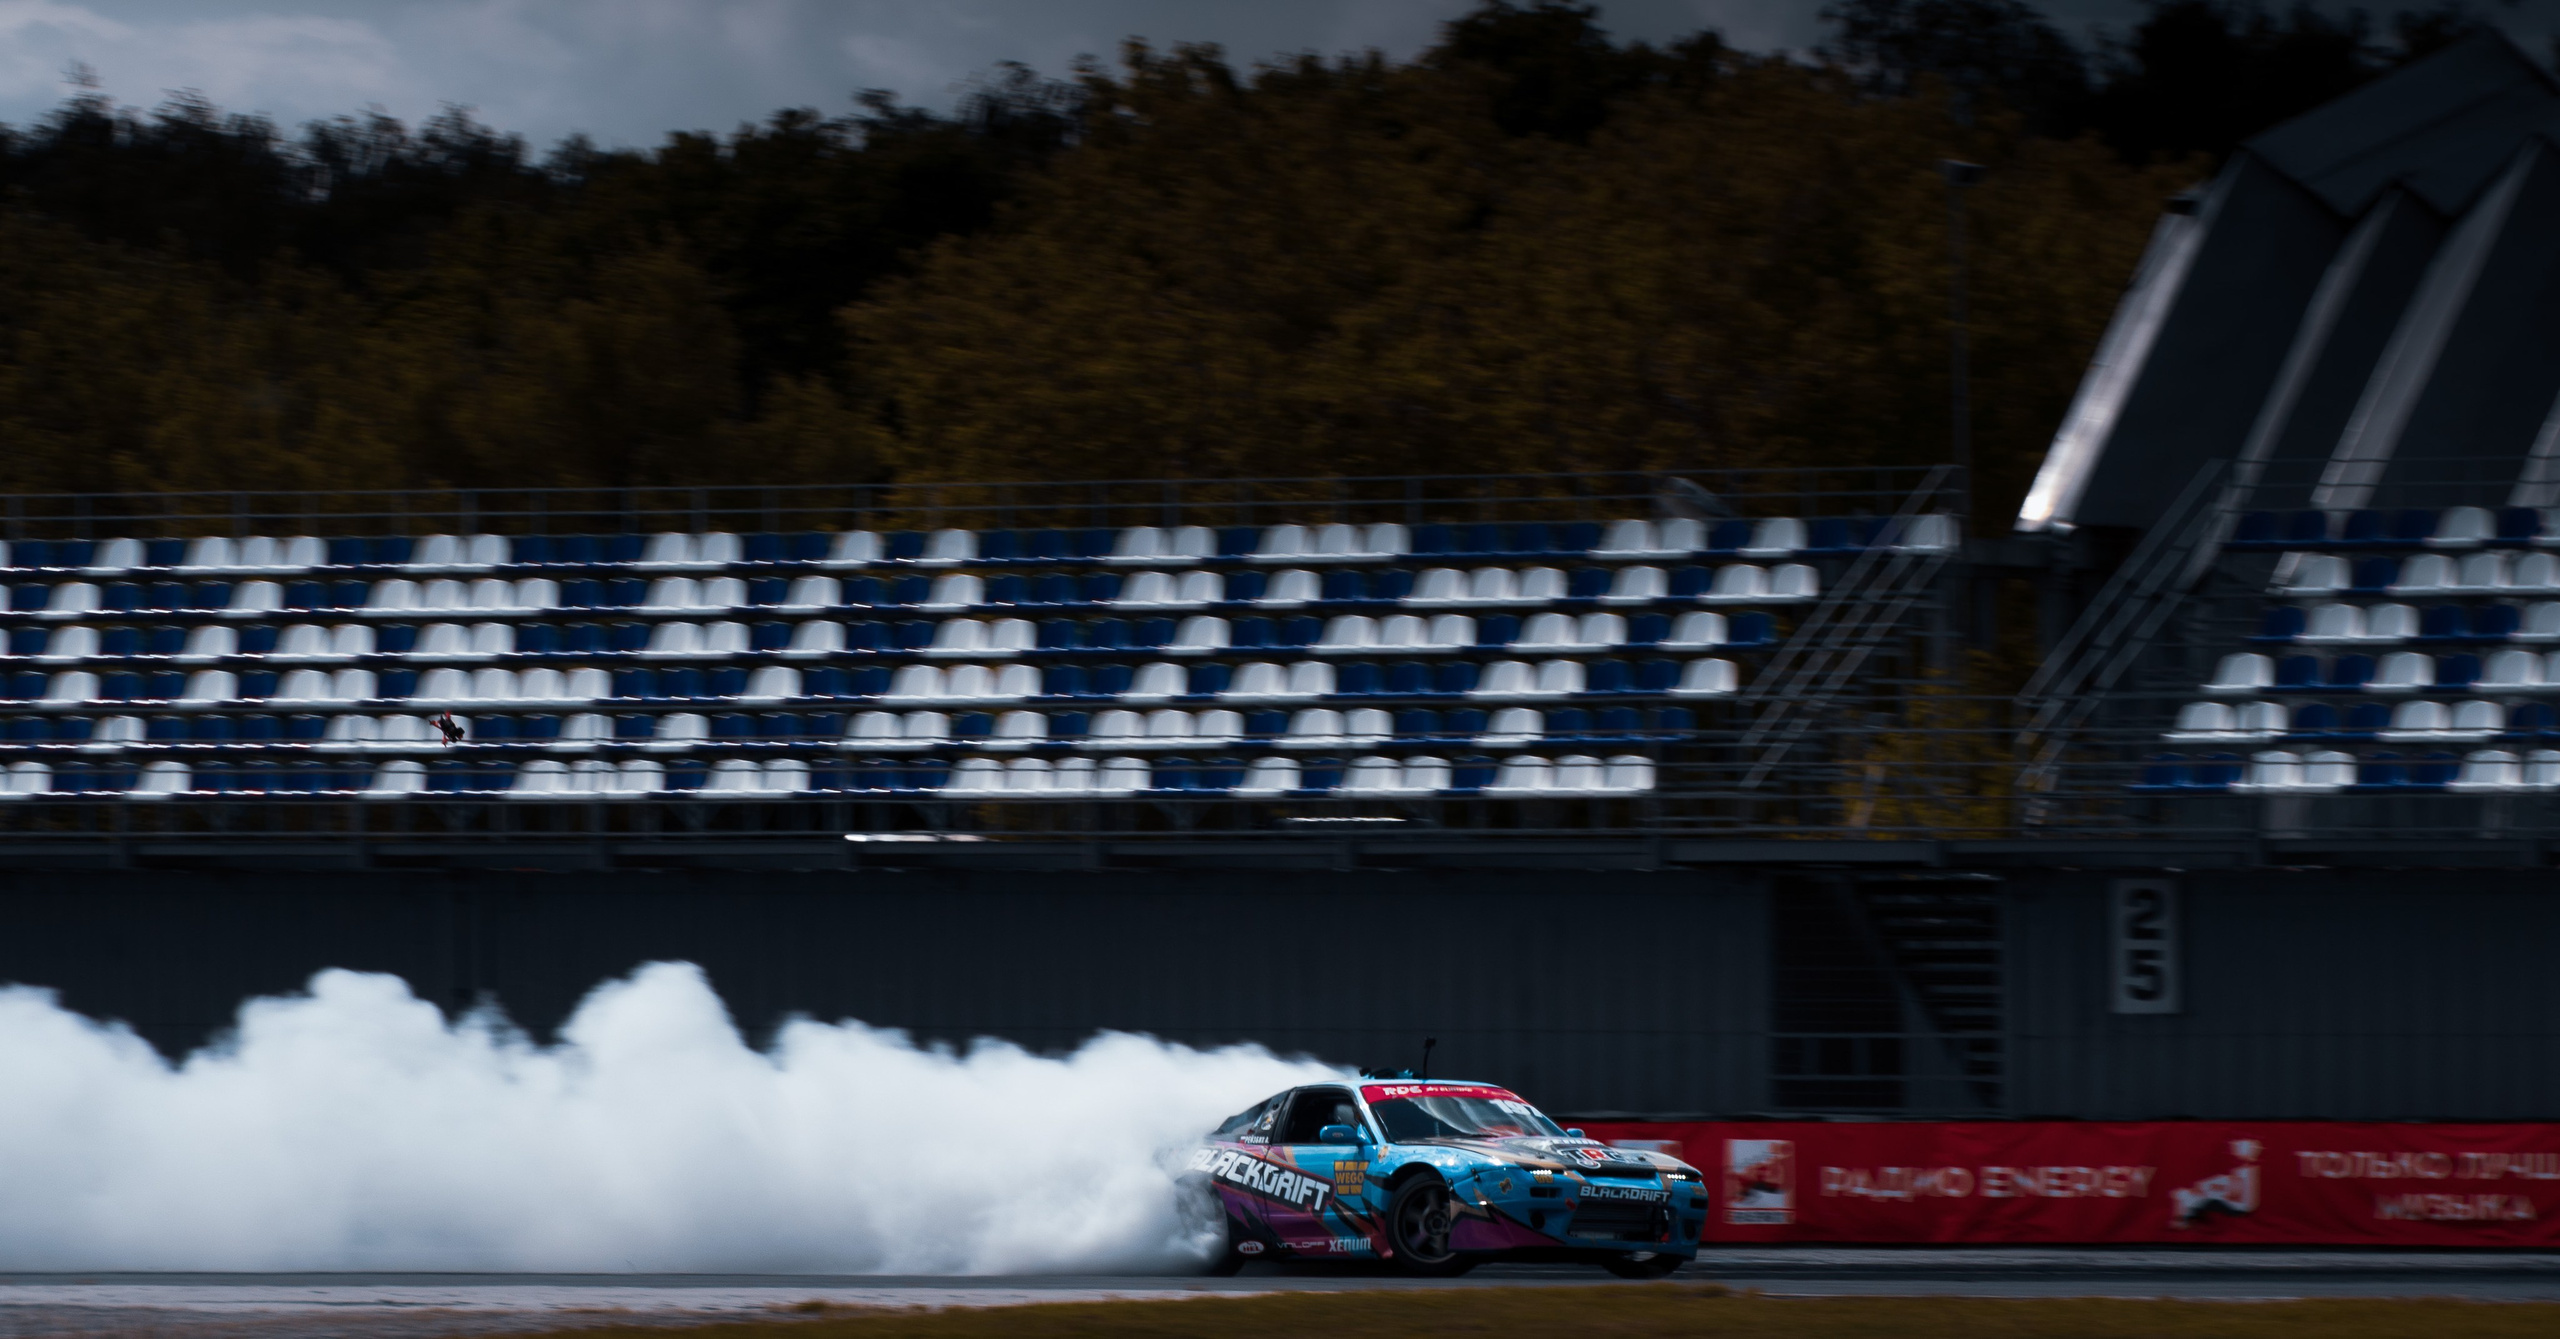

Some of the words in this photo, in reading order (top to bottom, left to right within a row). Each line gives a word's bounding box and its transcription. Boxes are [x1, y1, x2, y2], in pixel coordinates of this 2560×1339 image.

[2122, 888, 2165, 1001] 25
[1187, 1148, 1331, 1211] BLACKDRIFT
[1335, 1171, 1365, 1185] WEGO
[1819, 1165, 1975, 1203] РАДИО
[1979, 1165, 2158, 1199] ENERGY
[1579, 1186, 1671, 1203] BLACKDRIFT
[1328, 1237, 1372, 1253] XENUM
